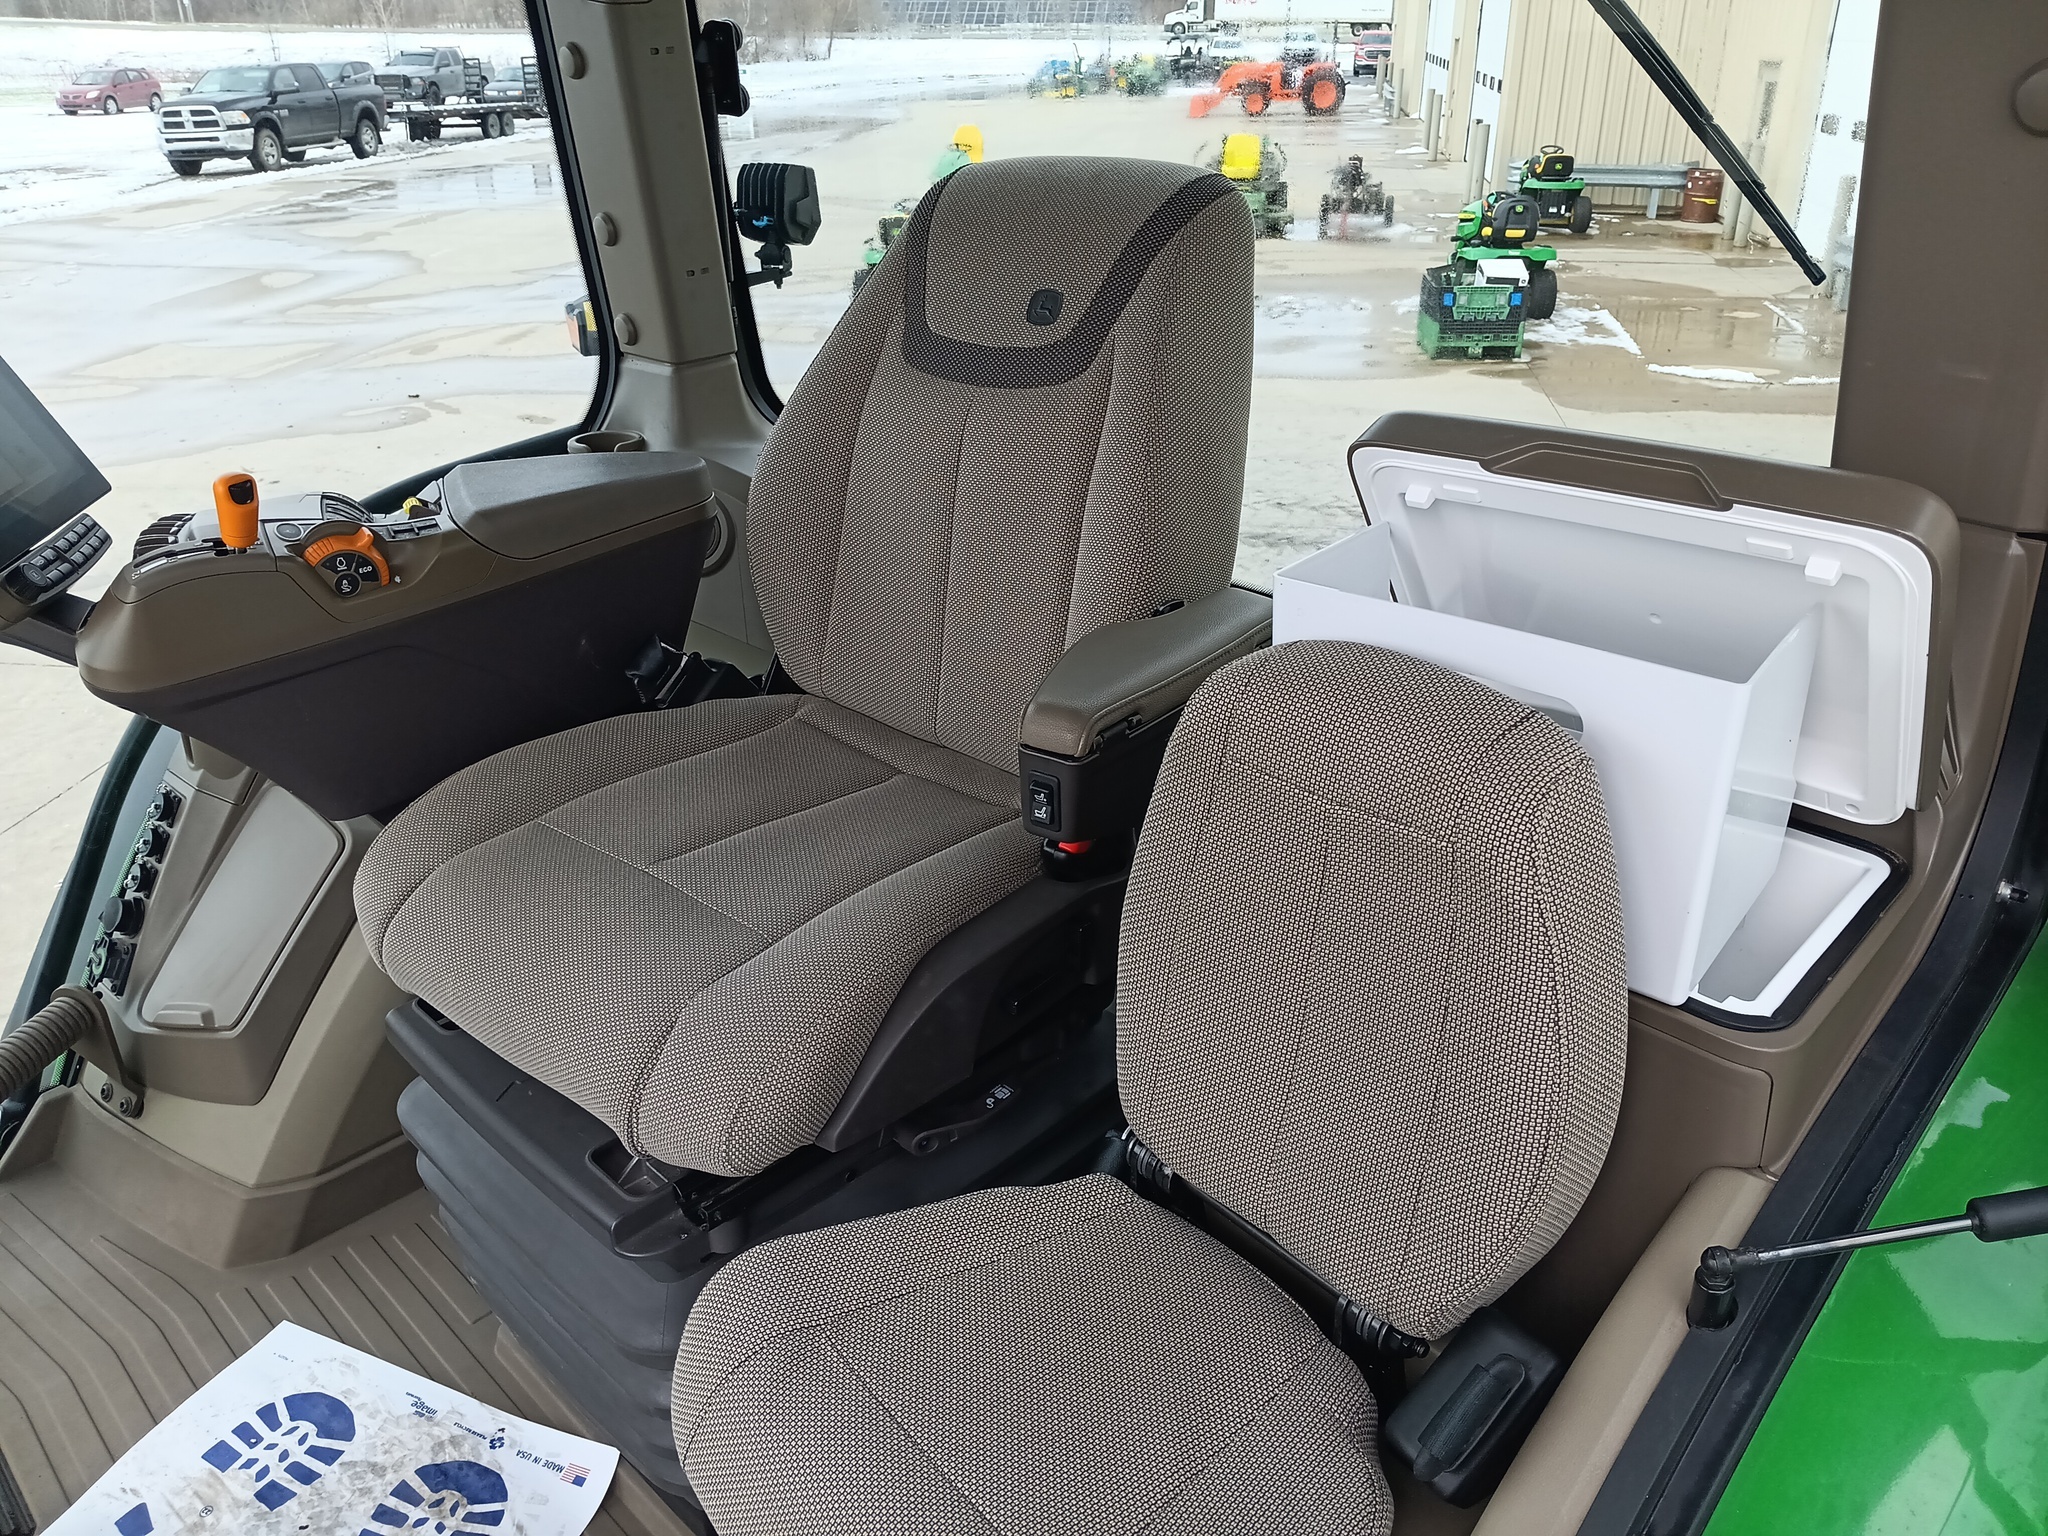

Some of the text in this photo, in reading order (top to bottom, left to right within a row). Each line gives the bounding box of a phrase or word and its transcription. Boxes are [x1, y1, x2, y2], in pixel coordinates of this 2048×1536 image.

[359, 565, 373, 574] ECO
[515, 1449, 566, 1473] MADE IN USA
